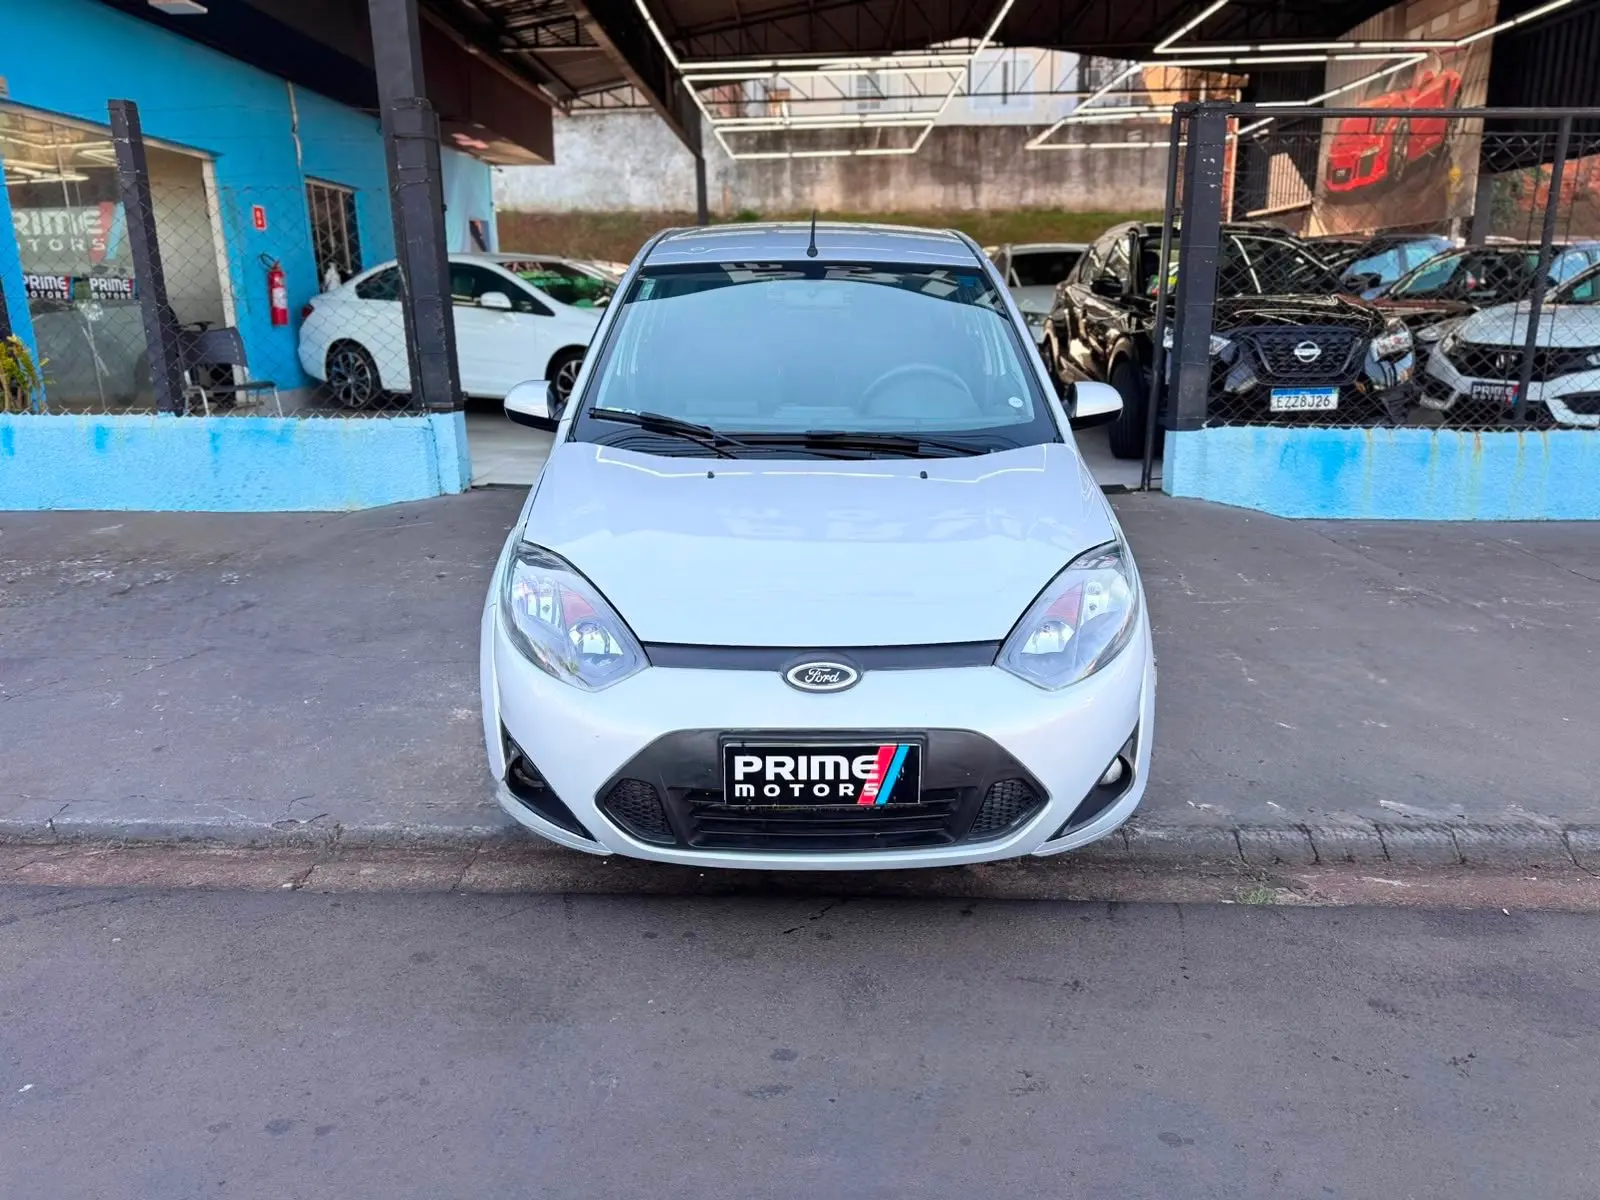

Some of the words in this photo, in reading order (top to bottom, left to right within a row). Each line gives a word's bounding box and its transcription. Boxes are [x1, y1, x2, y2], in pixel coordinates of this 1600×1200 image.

[12, 210, 102, 236] RIME
[17, 238, 105, 252] TORS
[89, 277, 131, 291] PRIME
[26, 290, 69, 300] OTORS
[1276, 395, 1331, 409] EZZ8J26
[804, 667, 840, 684] Ford
[734, 755, 879, 781] PRIME
[734, 783, 879, 797] MOTORS
